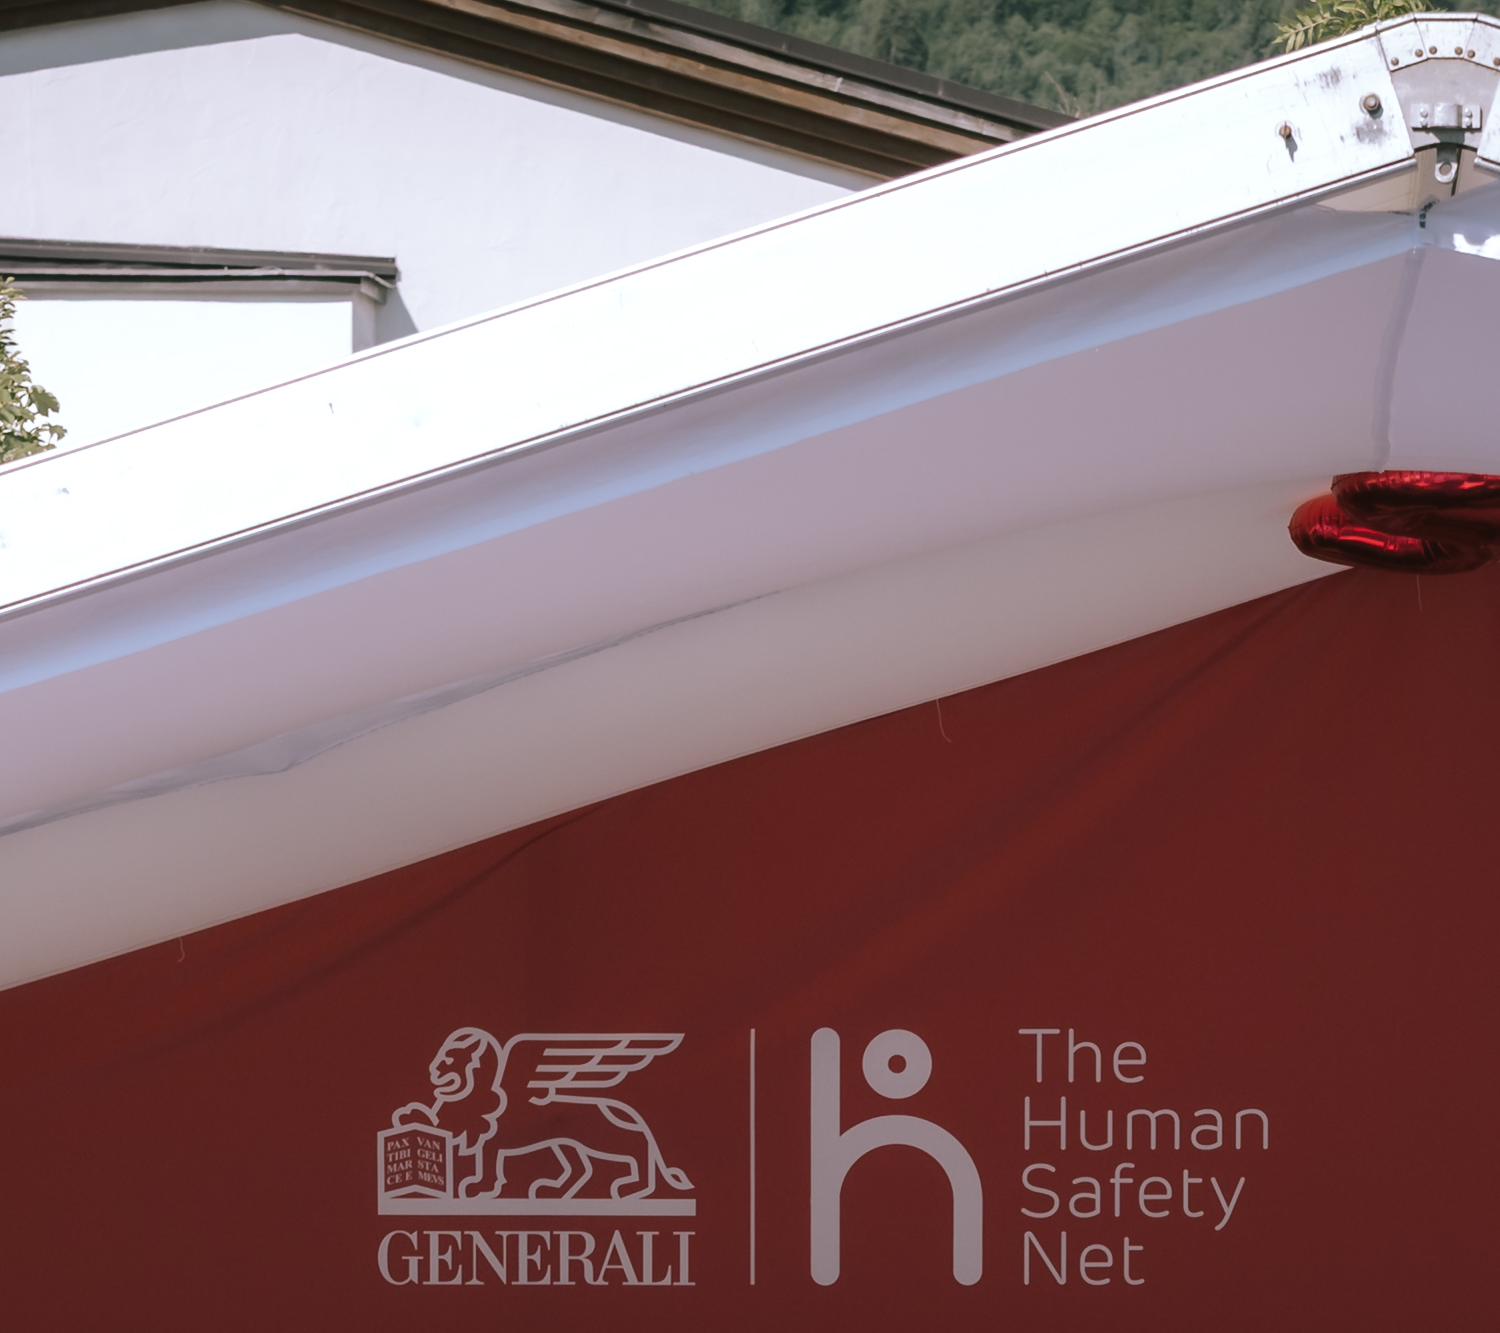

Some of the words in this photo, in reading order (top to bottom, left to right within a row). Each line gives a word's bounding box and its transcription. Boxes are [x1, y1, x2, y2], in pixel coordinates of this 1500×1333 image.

[1017, 1027, 1147, 1085] The
[1021, 1095, 1271, 1152] Human
[1018, 1162, 1247, 1232] Safety
[377, 1229, 697, 1287] GENERALI
[1022, 1229, 1147, 1287] Net
